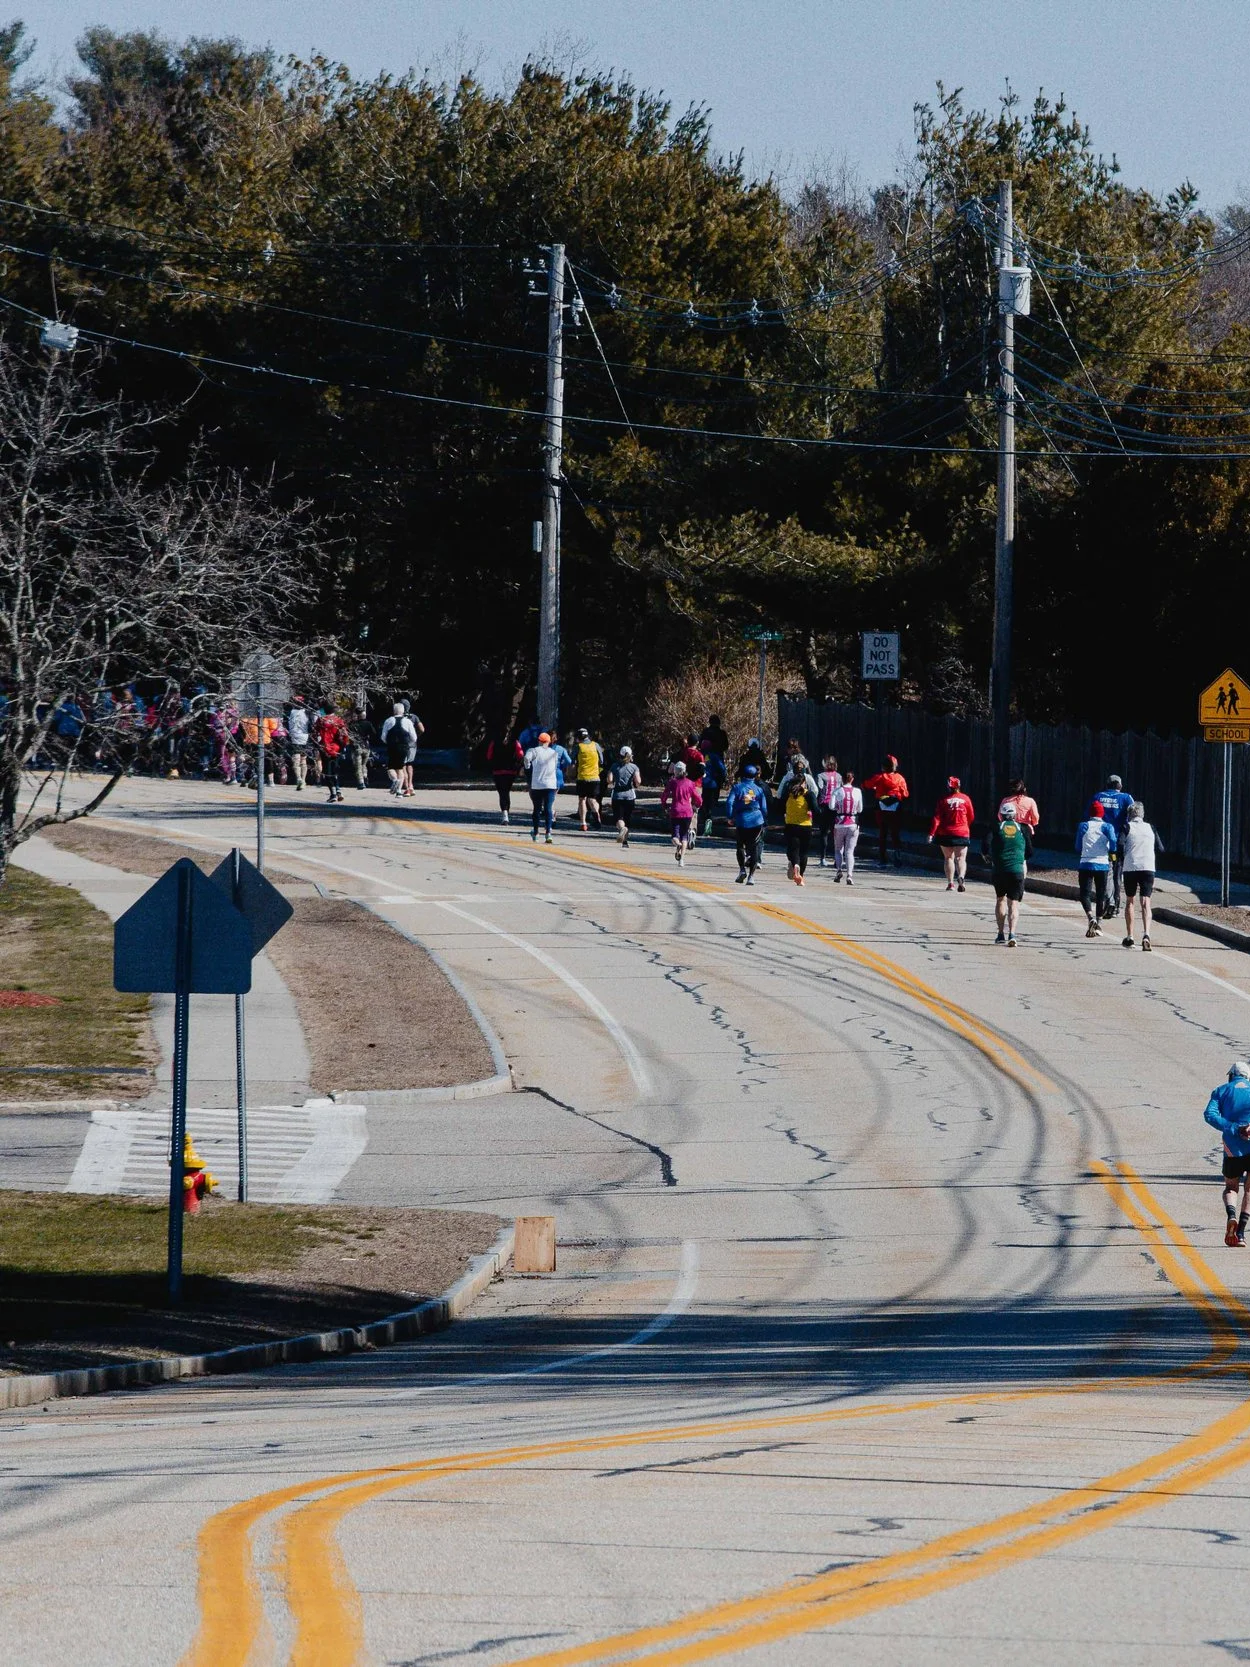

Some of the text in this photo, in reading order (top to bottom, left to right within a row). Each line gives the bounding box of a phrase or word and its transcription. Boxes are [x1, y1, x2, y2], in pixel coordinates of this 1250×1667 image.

[873, 637, 888, 648] DO
[870, 650, 891, 661] NOT
[865, 664, 895, 674] PASS
[1209, 729, 1246, 739] SCHOOL
